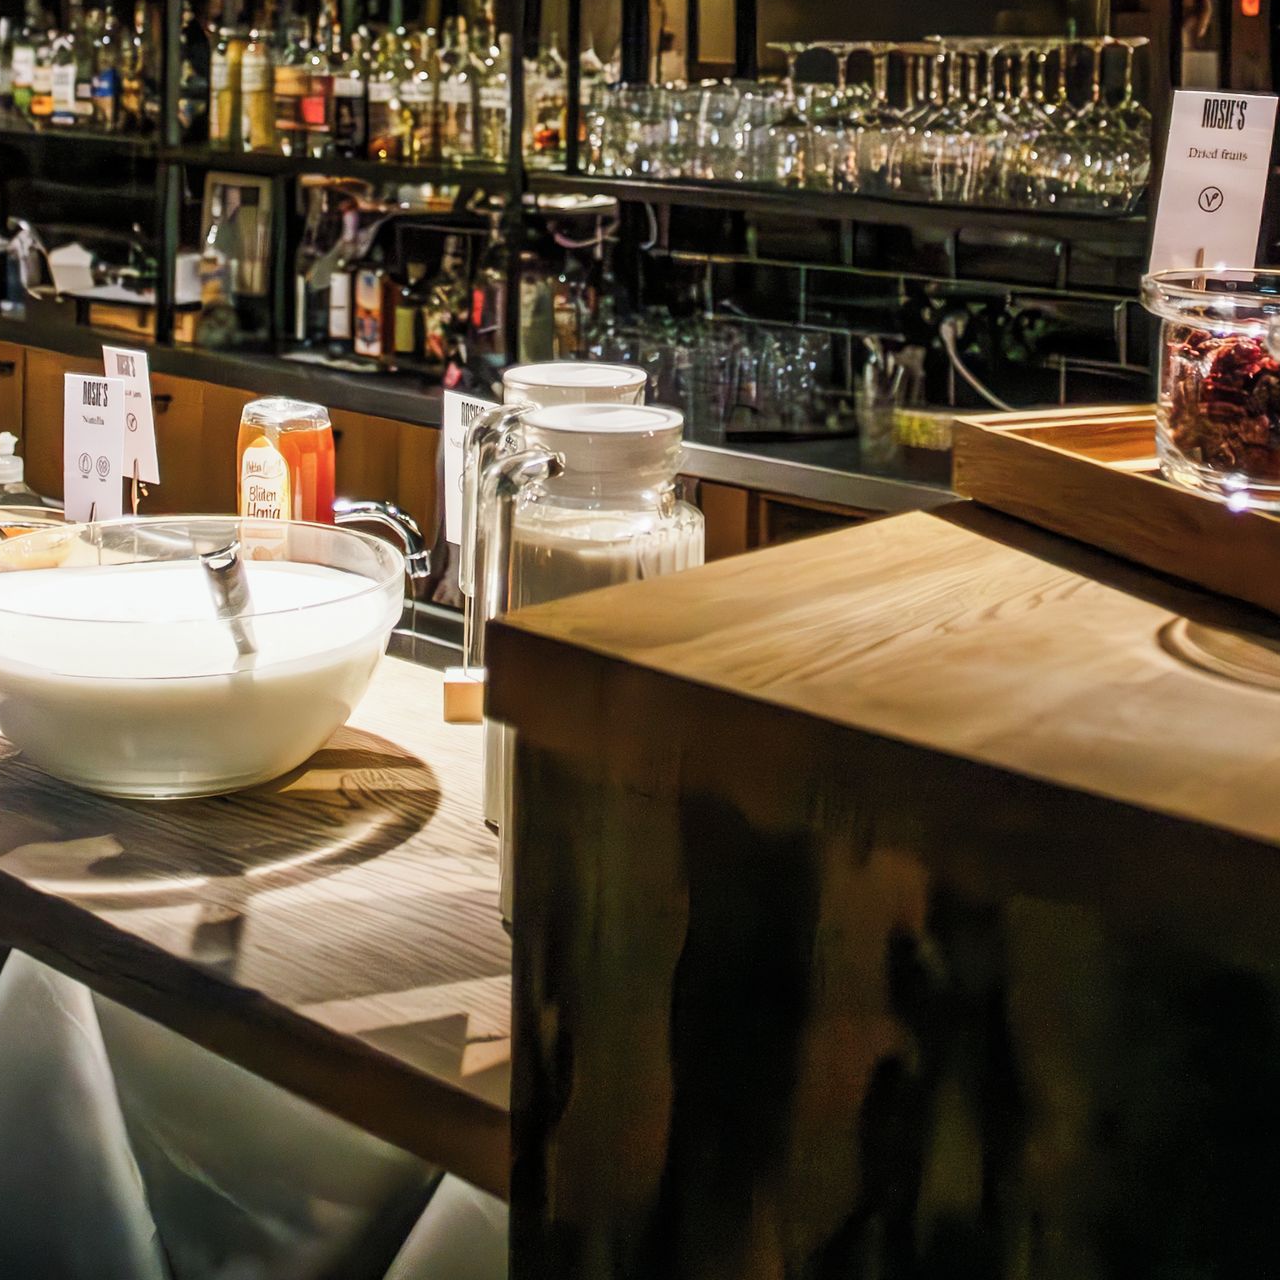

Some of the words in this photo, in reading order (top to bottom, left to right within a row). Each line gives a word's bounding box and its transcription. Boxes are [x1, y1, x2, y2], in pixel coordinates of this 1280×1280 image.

[1201, 99, 1247, 131] ROSIE'S
[1188, 147, 1218, 159] Dried
[1221, 149, 1248, 161] fruits
[83, 381, 108, 407] ROSIE'S
[249, 485, 276, 502] Blüten
